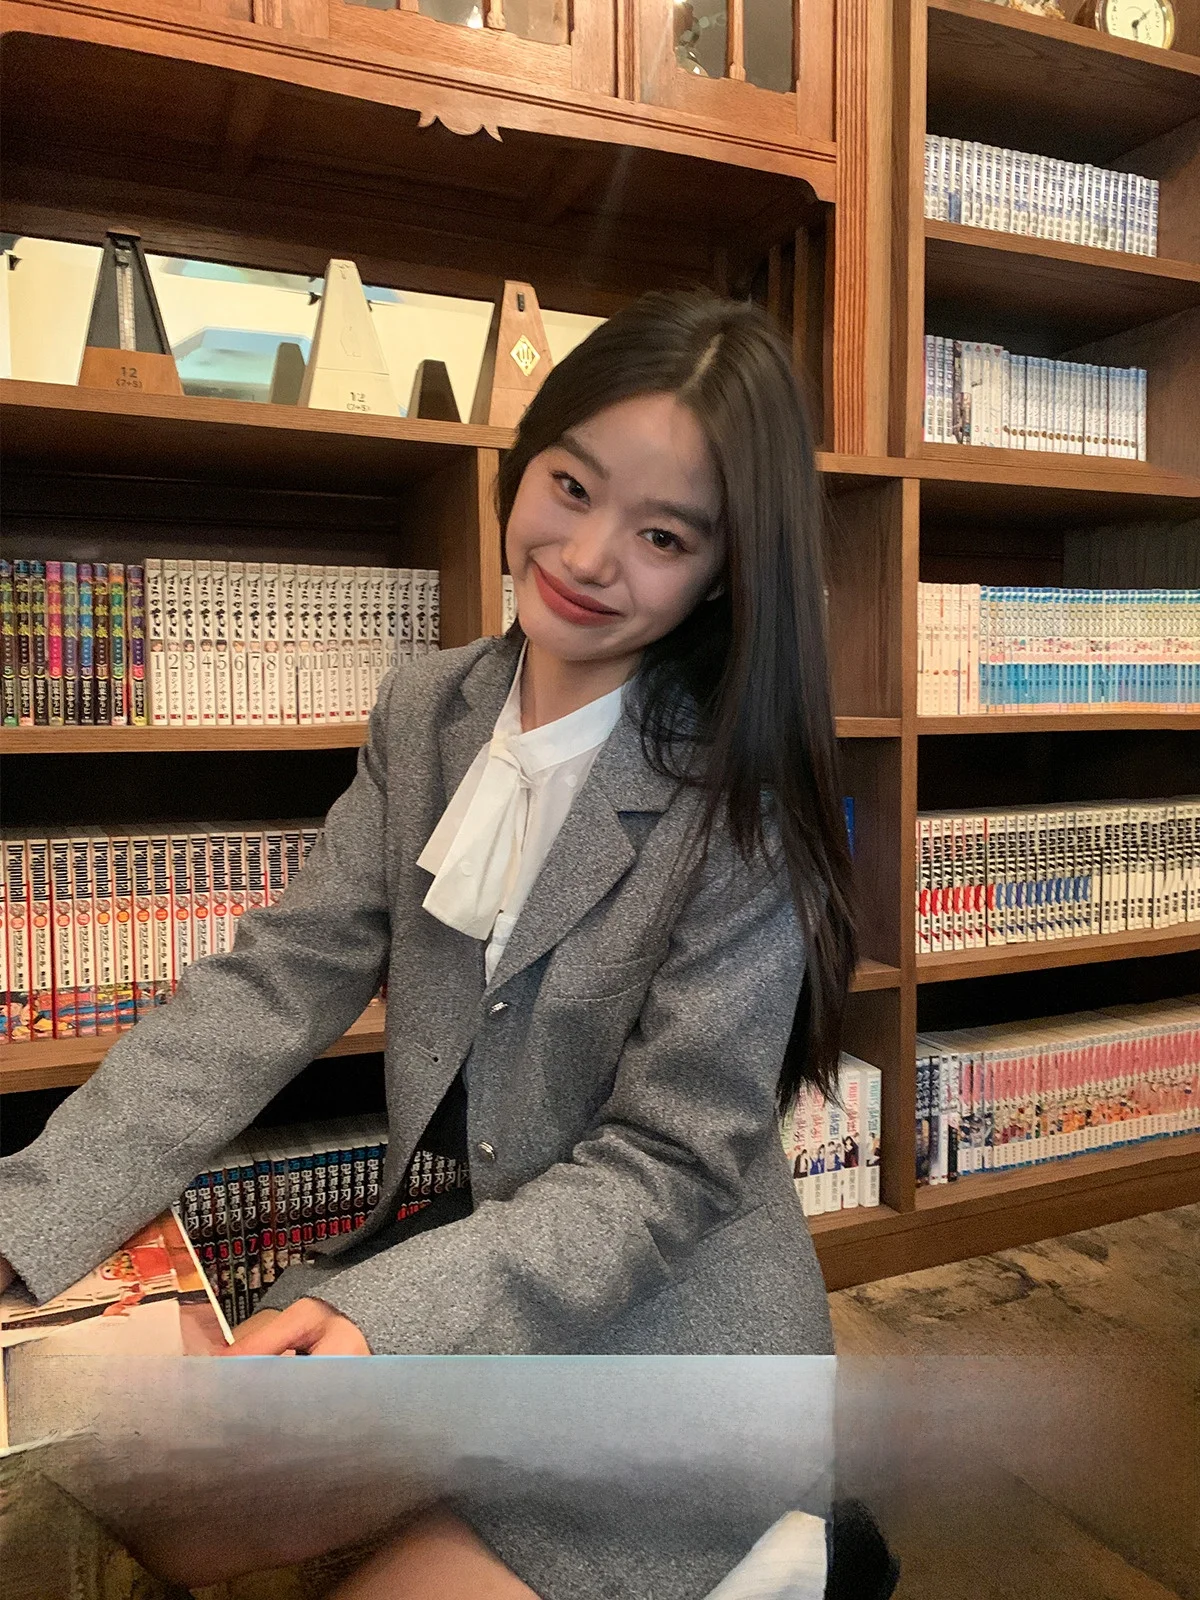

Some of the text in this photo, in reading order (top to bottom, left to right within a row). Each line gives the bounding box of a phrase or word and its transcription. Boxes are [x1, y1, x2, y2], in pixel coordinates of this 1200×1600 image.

[120, 366, 138, 378] 12
[350, 391, 366, 402] 12
[148, 573, 161, 637] ばらかもん
[164, 572, 178, 637] ばらかもん
[180, 573, 194, 638] ばらかもん
[198, 573, 211, 638] ばらかもん
[213, 573, 227, 637] ばらかもん
[231, 576, 244, 639] ばらかもん
[248, 576, 261, 639] ばらかもん
[264, 577, 278, 639] ばらかもん
[282, 577, 295, 639] ばらかもん
[298, 580, 310, 638] ばらかもん
[312, 579, 324, 638] ばらかもん
[326, 579, 338, 638] ばらかもん
[342, 579, 354, 638] ばらかもん
[358, 580, 370, 638] ばらかもん
[371, 580, 383, 637] ばらかもん
[386, 580, 398, 638] ばらかもん
[400, 581, 412, 638] ばらかもん
[4, 666, 13, 675] 5
[21, 667, 29, 675] 6
[37, 666, 44, 675] 7
[52, 667, 59, 675] 8
[66, 667, 73, 675] 9
[81, 667, 92, 675] 10
[97, 667, 107, 675] 11
[113, 667, 123, 675] 12
[133, 667, 143, 676] 13
[154, 655, 161, 670] 1
[168, 654, 179, 670] 2
[185, 655, 195, 670] 3
[202, 654, 212, 670] 4
[217, 654, 227, 670] 5
[234, 655, 244, 670] 6
[251, 655, 260, 670] 7
[266, 655, 277, 671] 8
[285, 655, 294, 670] 9
[299, 655, 310, 669] 10
[313, 655, 324, 669] 11
[327, 654, 338, 668] 12
[342, 654, 354, 668] 13
[358, 654, 370, 667] 14
[372, 653, 382, 667] 15
[386, 653, 397, 667] 16
[154, 672, 163, 711] ヨシノサツキ
[170, 672, 179, 711] ヨシノサツキ
[186, 672, 195, 712] ヨシノサツキ
[203, 672, 212, 711] ヨシノサツキ
[218, 672, 227, 711] ヨシノサツキ
[235, 673, 244, 711] ヨシノサツキ
[252, 673, 261, 711] ヨシノサツキ
[268, 672, 276, 711] ヨシノサツキ
[286, 672, 294, 711] ヨシノサツキ
[302, 672, 310, 710] ヨシノサツキ
[330, 671, 338, 708] ヨシノサツキ
[361, 670, 369, 708] ヨシノサツキ
[922, 837, 930, 879] GANTZ
[933, 837, 941, 878] GANTZ
[944, 835, 952, 877] GANTZ
[955, 835, 963, 877] GANTZ
[965, 834, 973, 876] GANTZ
[976, 833, 984, 875] GANTZ
[989, 833, 997, 874] GANTZ
[258, 1175, 271, 1213] 鬼滅の刃
[275, 1175, 286, 1214] 鬼滅の刃
[289, 1172, 300, 1211] 鬼滅の刃
[301, 1170, 312, 1208] 鬼滅の刃
[315, 1167, 326, 1205] 鬼滅の刃
[328, 1165, 339, 1202] 鬼滅の刃
[340, 1163, 351, 1201] 鬼滅の刃
[354, 1161, 364, 1199] 鬼滅の刃
[367, 1159, 379, 1196] 鬼滅の刃
[185, 1189, 199, 1230] 鬼滅の刃
[199, 1188, 213, 1229] 鬼滅の刃
[213, 1185, 226, 1225] 鬼滅の刃
[228, 1183, 241, 1222] 鬼滅の刃
[243, 1180, 256, 1219] 鬼滅の刃
[233, 1242, 242, 1255] 6
[249, 1238, 257, 1252] 7
[263, 1233, 271, 1245] 8
[279, 1233, 285, 1246] 9
[304, 1227, 312, 1241] 11
[317, 1224, 326, 1238] 12
[205, 1246, 214, 1260] 4
[219, 1245, 227, 1258] 5
